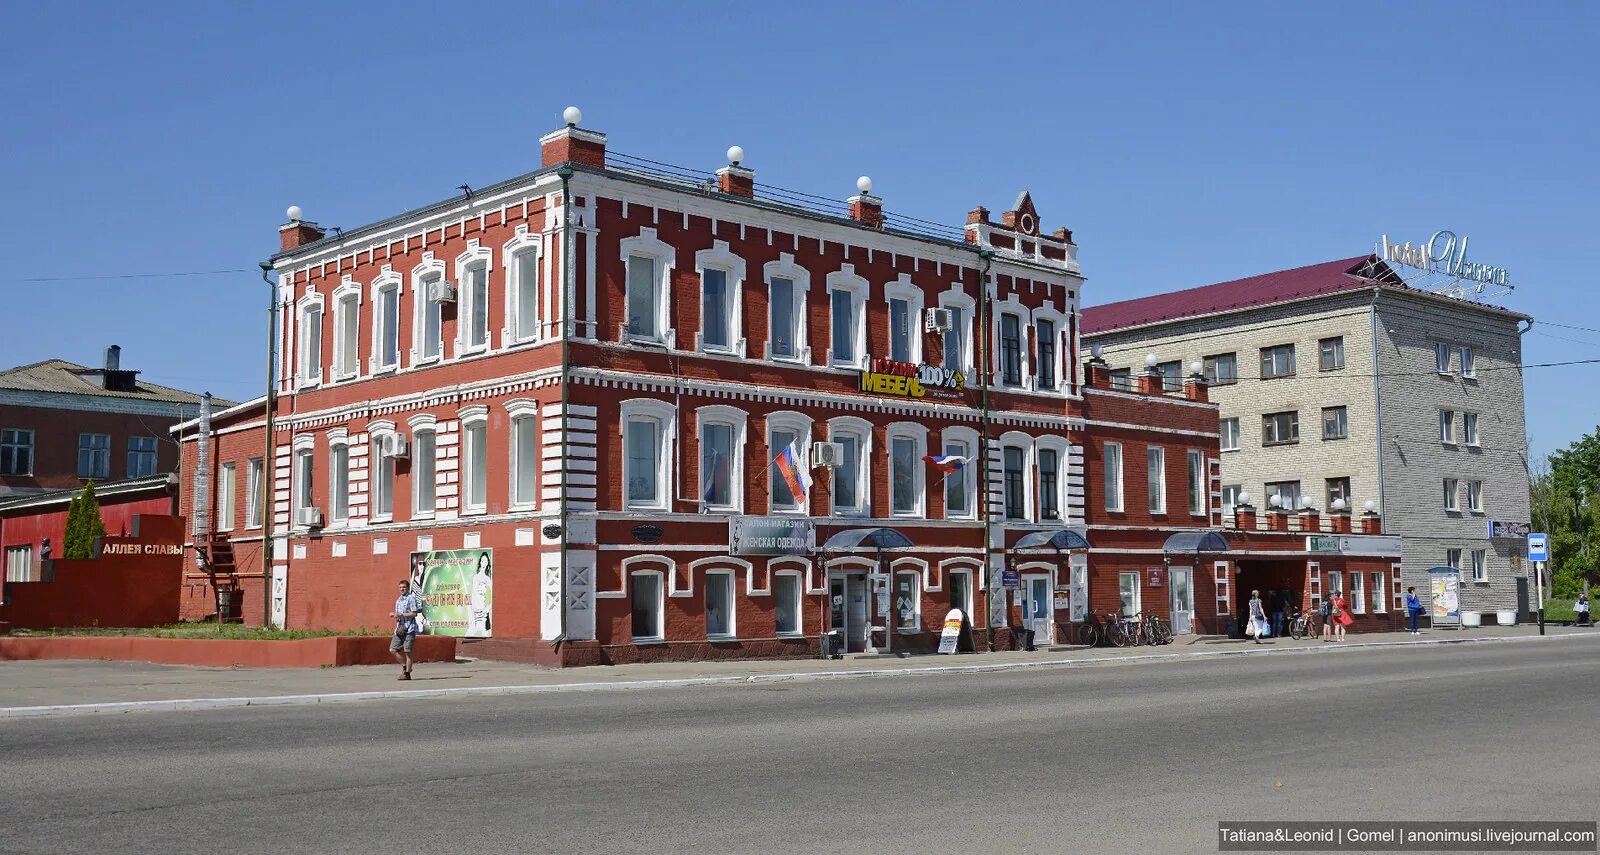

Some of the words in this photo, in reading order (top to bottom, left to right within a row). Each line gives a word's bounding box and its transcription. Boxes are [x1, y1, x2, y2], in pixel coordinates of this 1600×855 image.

[1382, 234, 1429, 270] hotel
[862, 372, 926, 397] МЕБЕЛЬ
[919, 364, 957, 389] 100%
[102, 543, 142, 555] АЛЛЕЯ
[144, 544, 183, 555] СЛАВЫ
[777, 537, 805, 550] ОДЕЖДА
